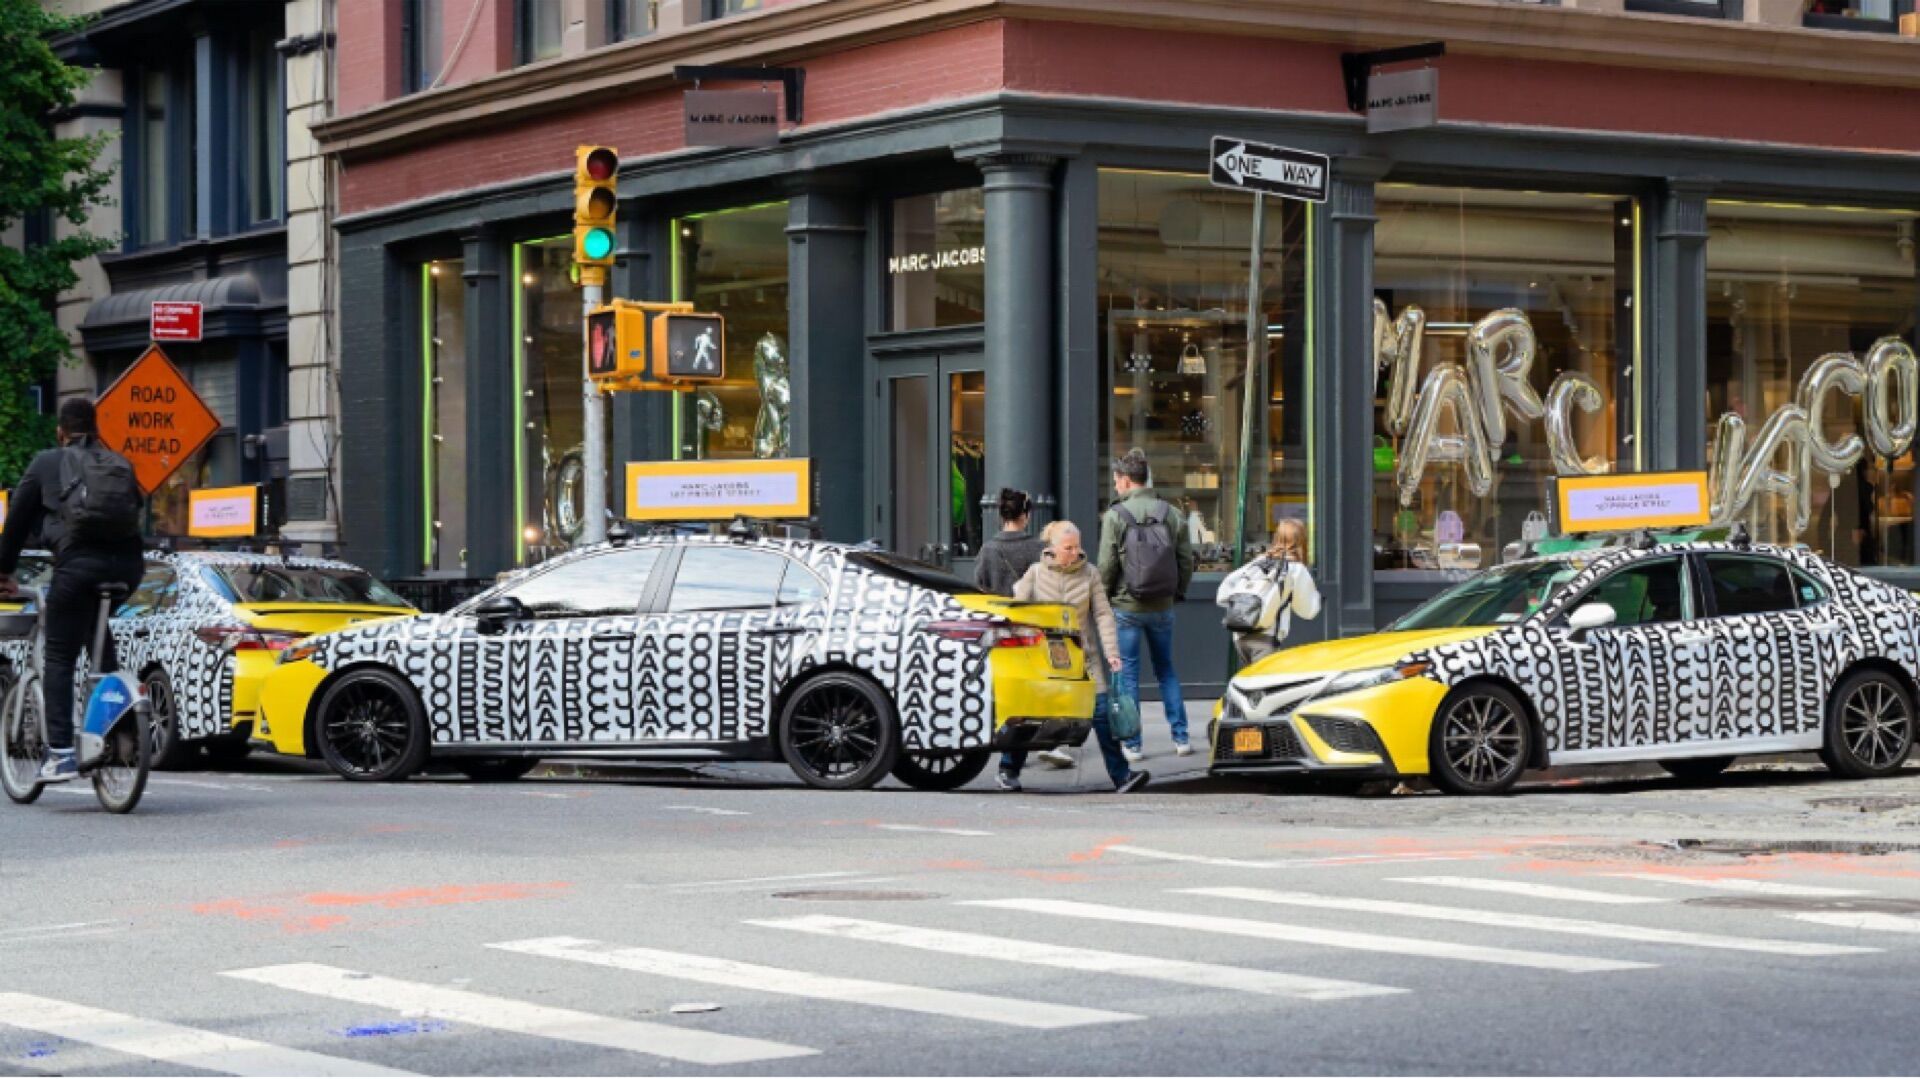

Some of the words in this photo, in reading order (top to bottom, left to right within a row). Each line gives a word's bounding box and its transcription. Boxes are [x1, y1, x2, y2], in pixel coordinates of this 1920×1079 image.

[1367, 97, 1393, 108] MARC
[1395, 93, 1431, 106] JACOBS
[689, 113, 724, 125] MARC
[727, 113, 778, 125] JACOBS
[1225, 152, 1262, 177] ONE
[1282, 161, 1318, 185] WAY
[889, 252, 928, 274] MARC
[930, 246, 985, 270] JACOBS
[130, 385, 177, 404] ROAD
[128, 411, 175, 430] WORK
[122, 436, 181, 455] AHEAD
